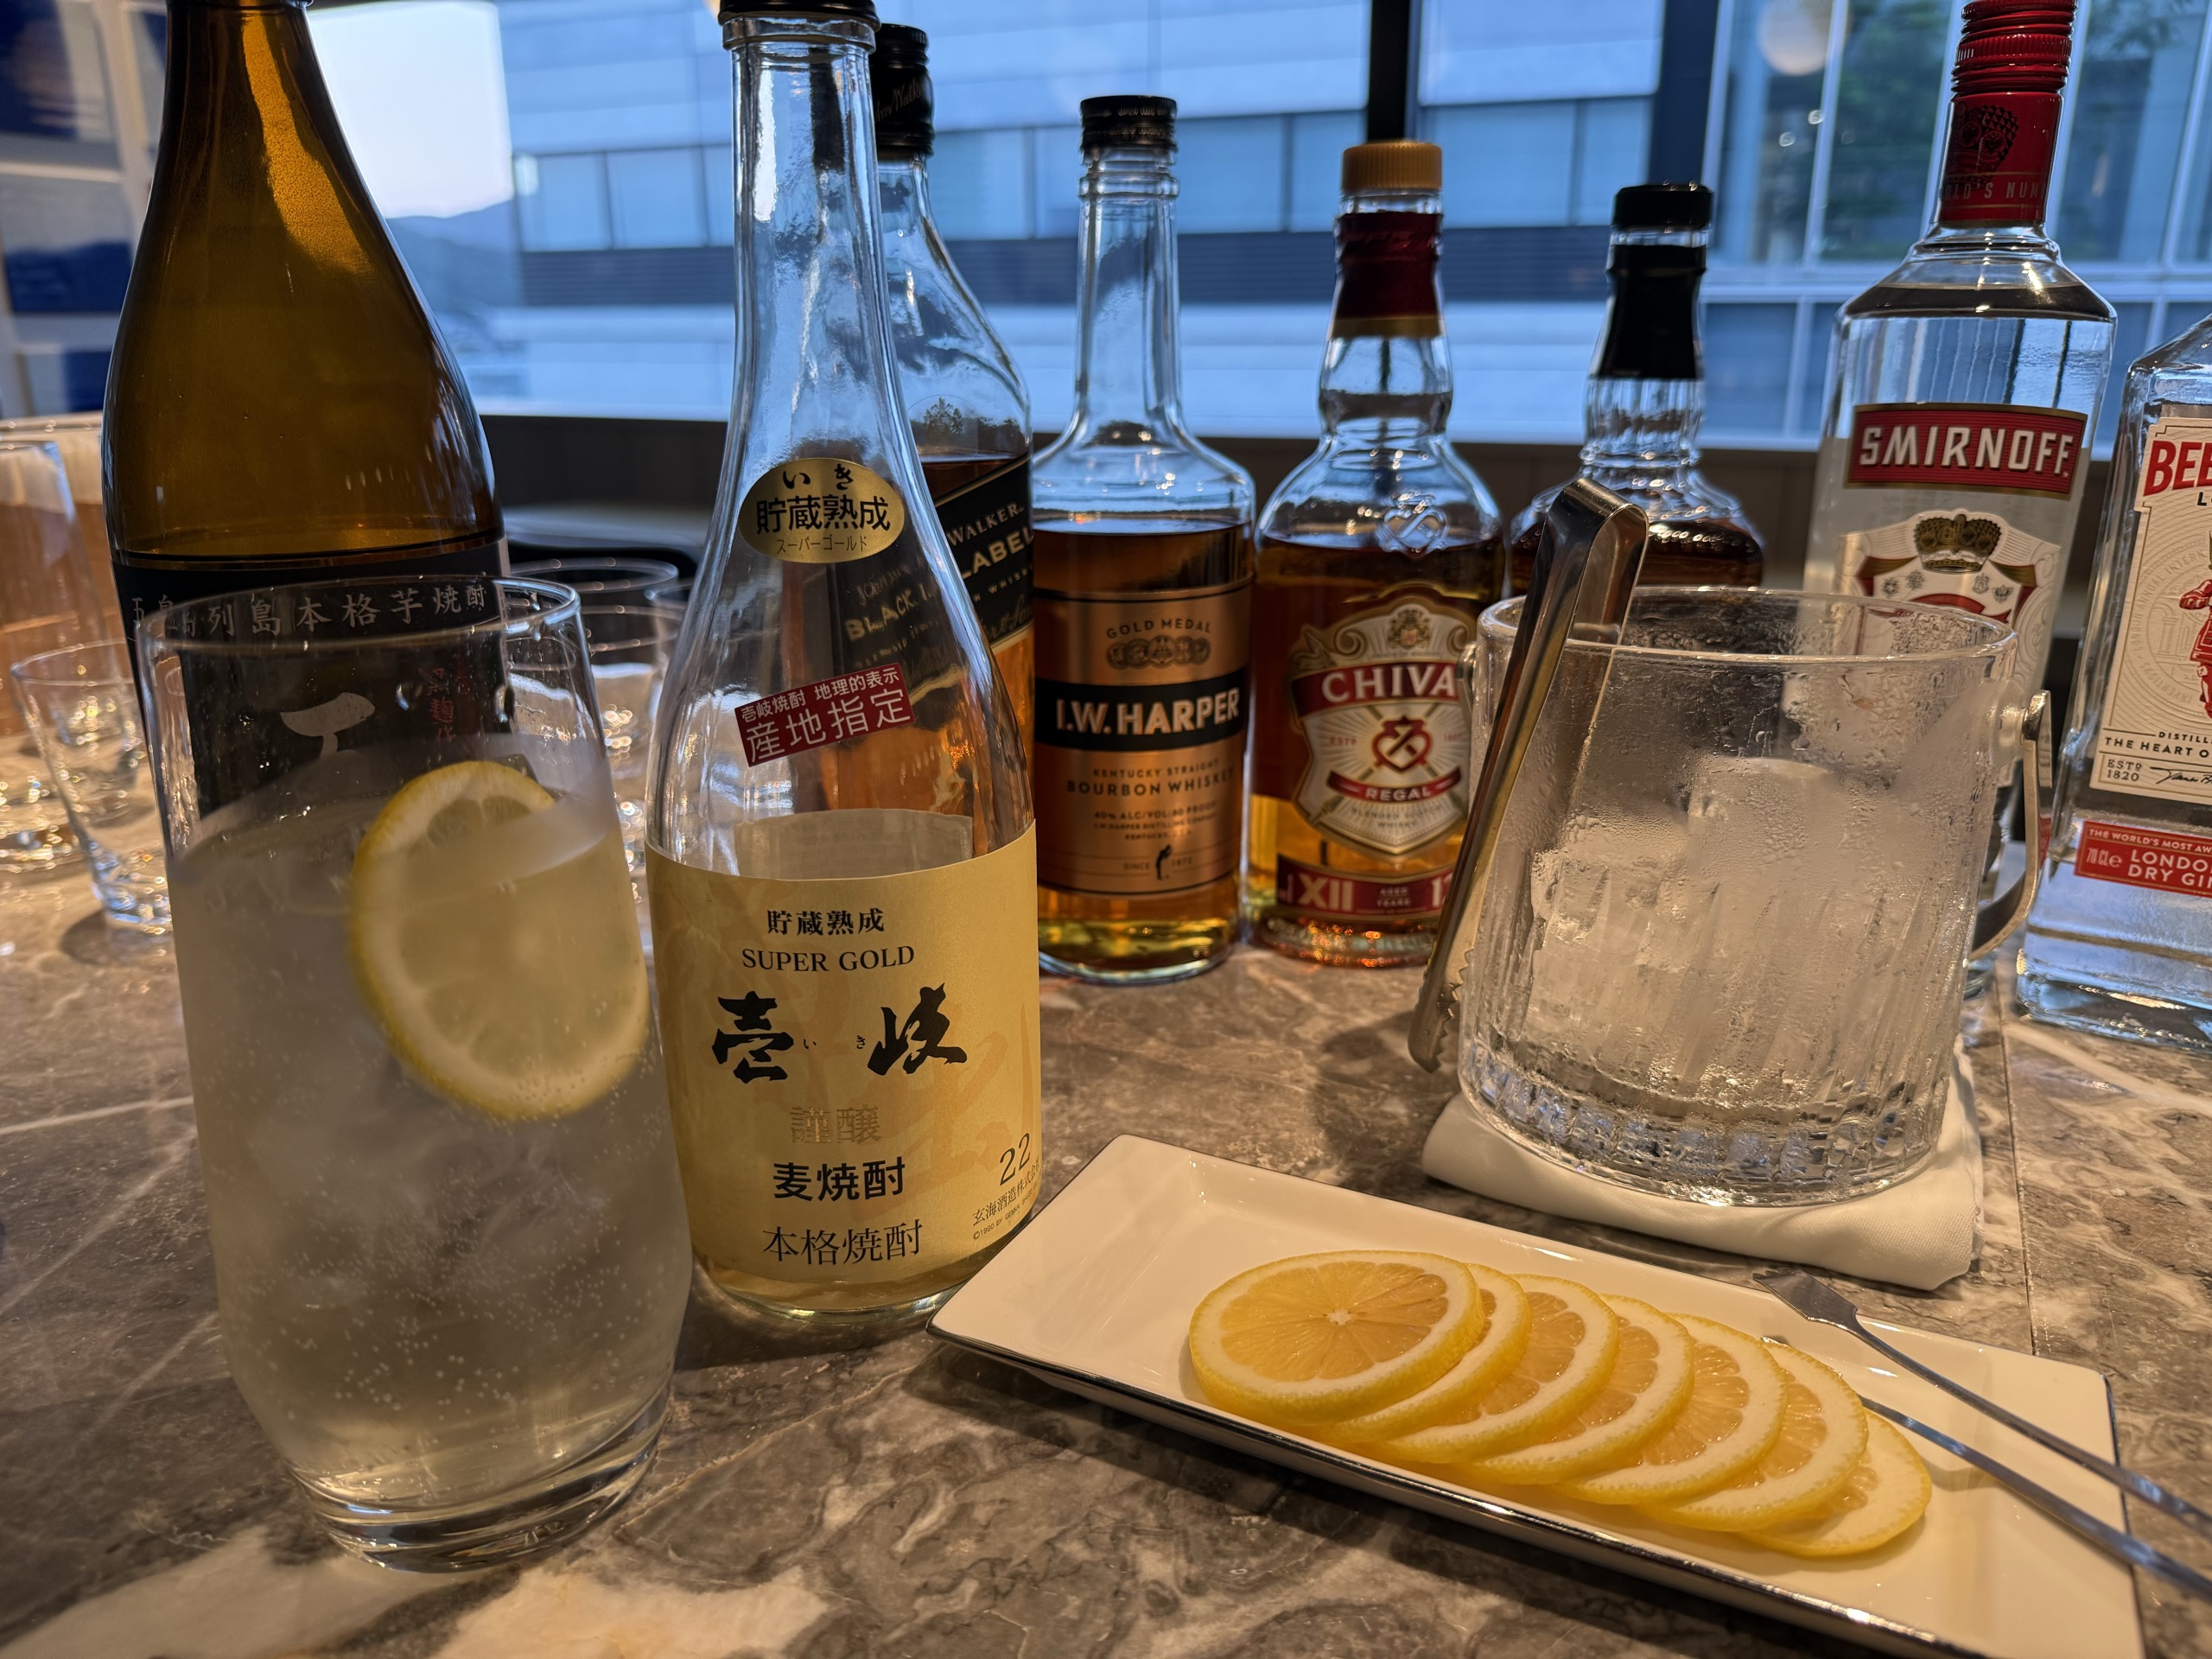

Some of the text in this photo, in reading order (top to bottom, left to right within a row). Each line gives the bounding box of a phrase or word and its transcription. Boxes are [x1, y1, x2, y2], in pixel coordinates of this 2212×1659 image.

[2005, 181, 2042, 200] NUM
[1859, 425, 2074, 475] SMIRNOFF
[756, 494, 891, 535] 貯蔵熟成
[947, 502, 1020, 546] WALKER
[777, 534, 868, 555] スーパーゴールド
[1106, 618, 1211, 639] GOLD MEDAL
[741, 667, 899, 722] 壱岐焼酎 地理的表示
[1322, 663, 1457, 702] CHIVA
[747, 689, 911, 763] 産地指定
[2158, 731, 2212, 744] DISTILL
[2105, 737, 2133, 749] THE
[2140, 741, 2193, 756] HEART
[1067, 766, 1234, 797] BOURBON WHISKEY
[1093, 759, 1219, 779] KENTUCKY STRAIGHT
[2107, 769, 2140, 782] 1820
[1364, 785, 1432, 802] REGAL
[2089, 829, 2212, 854] THE WORLD'S MOST AW
[2127, 864, 2174, 882] DRY
[2130, 849, 2212, 873] LONDO
[1297, 873, 1353, 912] XII
[766, 907, 885, 936] 貯蔵熟成
[742, 944, 915, 972] SUPER GOLD
[1000, 1132, 1031, 1185] 22
[772, 1156, 906, 1202] 麦焼酎
[763, 1218, 923, 1266] 本格焼酎
